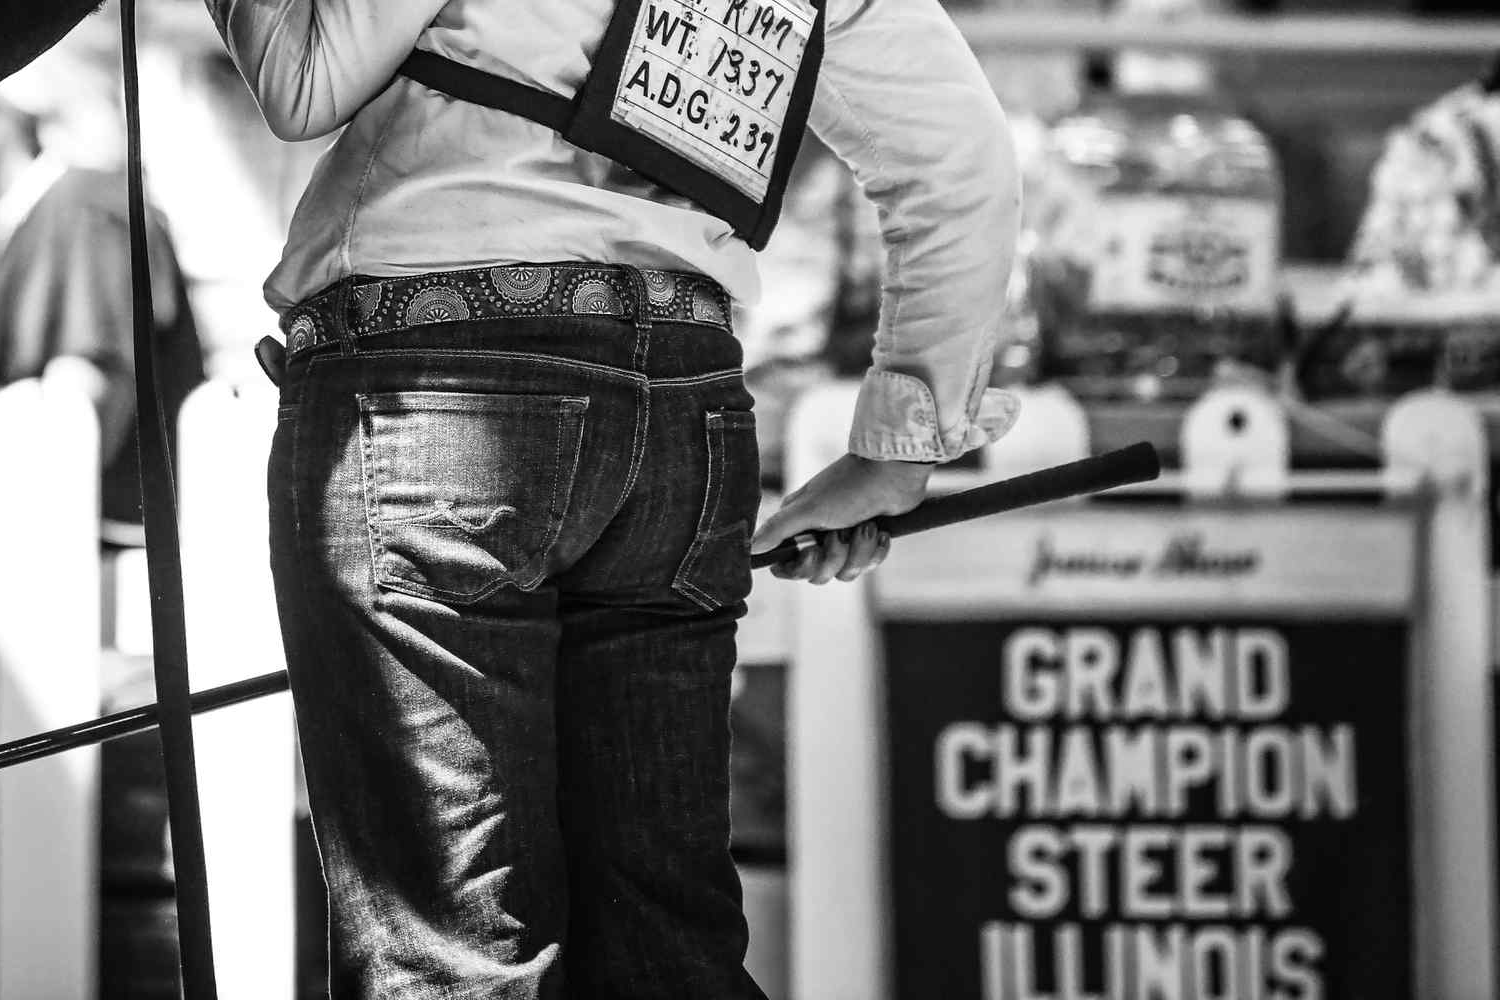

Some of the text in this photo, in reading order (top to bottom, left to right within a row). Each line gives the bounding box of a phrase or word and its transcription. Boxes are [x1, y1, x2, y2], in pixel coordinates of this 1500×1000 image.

[626, 61, 709, 130] A.D.G.
[645, 6, 784, 110] WT. 1337
[1004, 627, 1290, 720] GRAND
[936, 722, 1355, 819] CHAMPION
[1008, 823, 1293, 918] STEER
[981, 921, 1325, 1000] ILLINOIS
